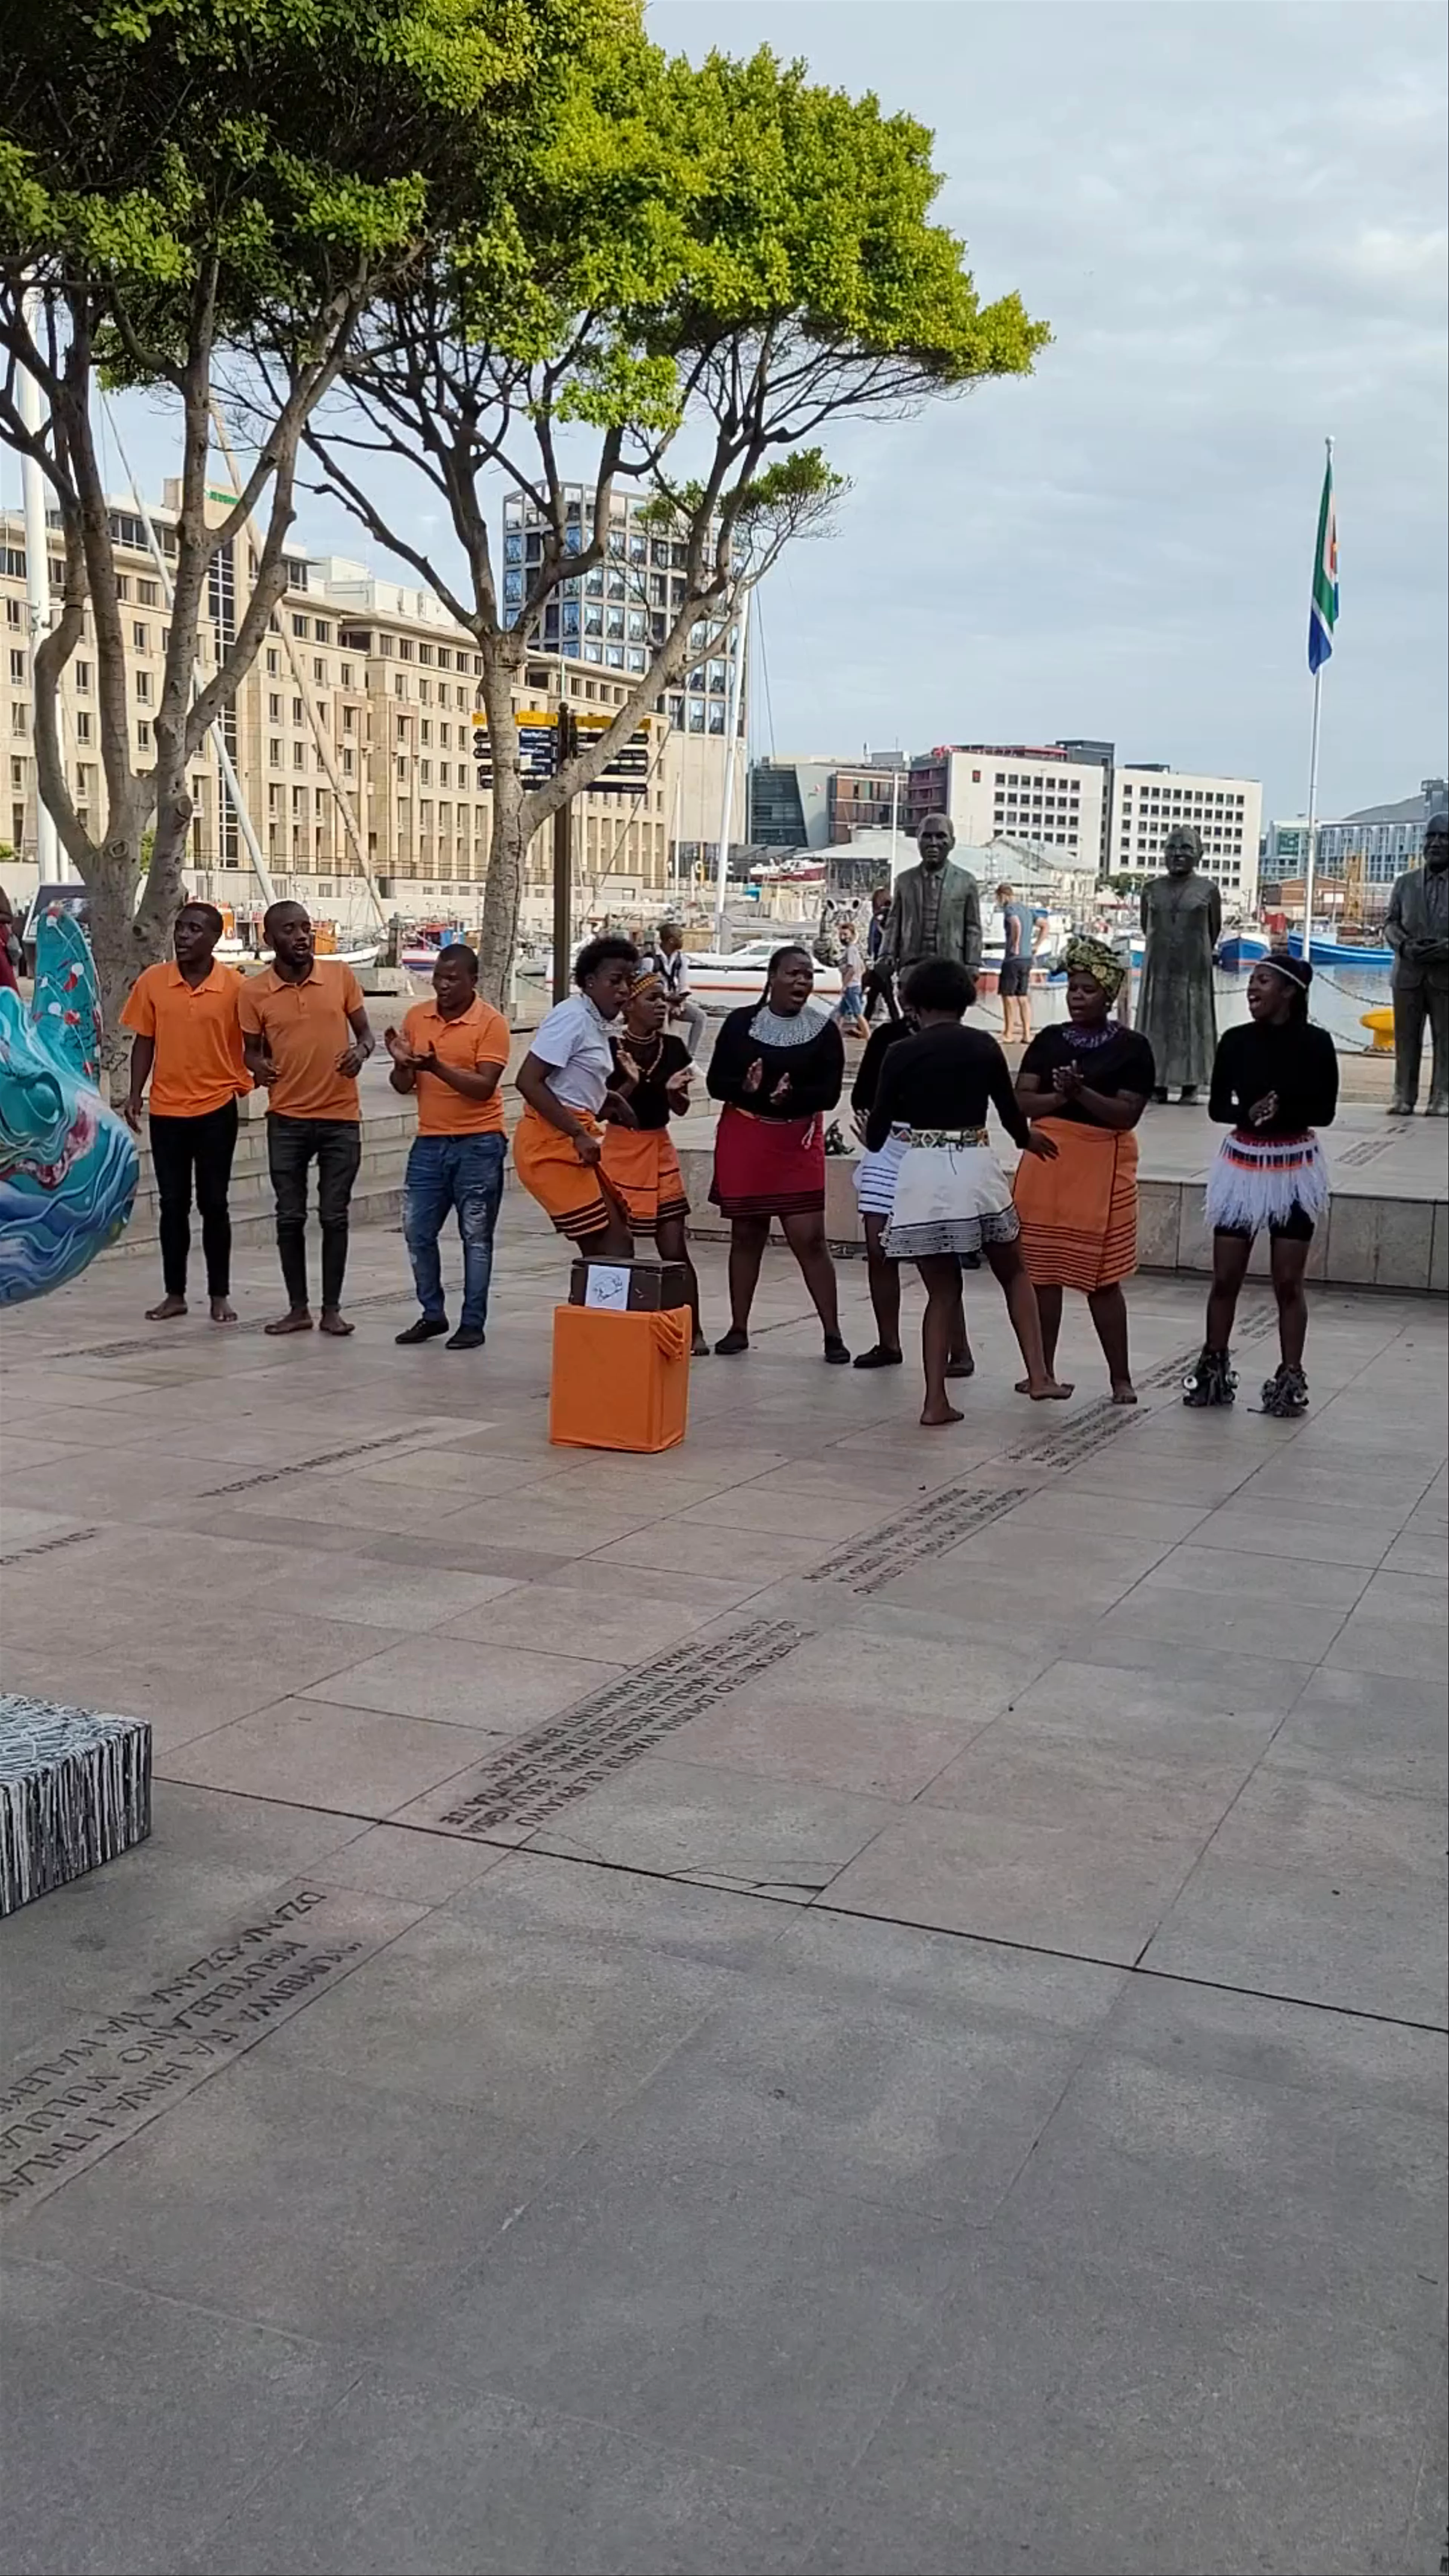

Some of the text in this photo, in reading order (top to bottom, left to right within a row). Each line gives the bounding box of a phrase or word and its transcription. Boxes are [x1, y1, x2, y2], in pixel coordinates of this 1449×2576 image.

[100, 2062, 192, 2111] HINA
[0, 2076, 121, 2159] VULULA
[85, 2117, 115, 2127] I
